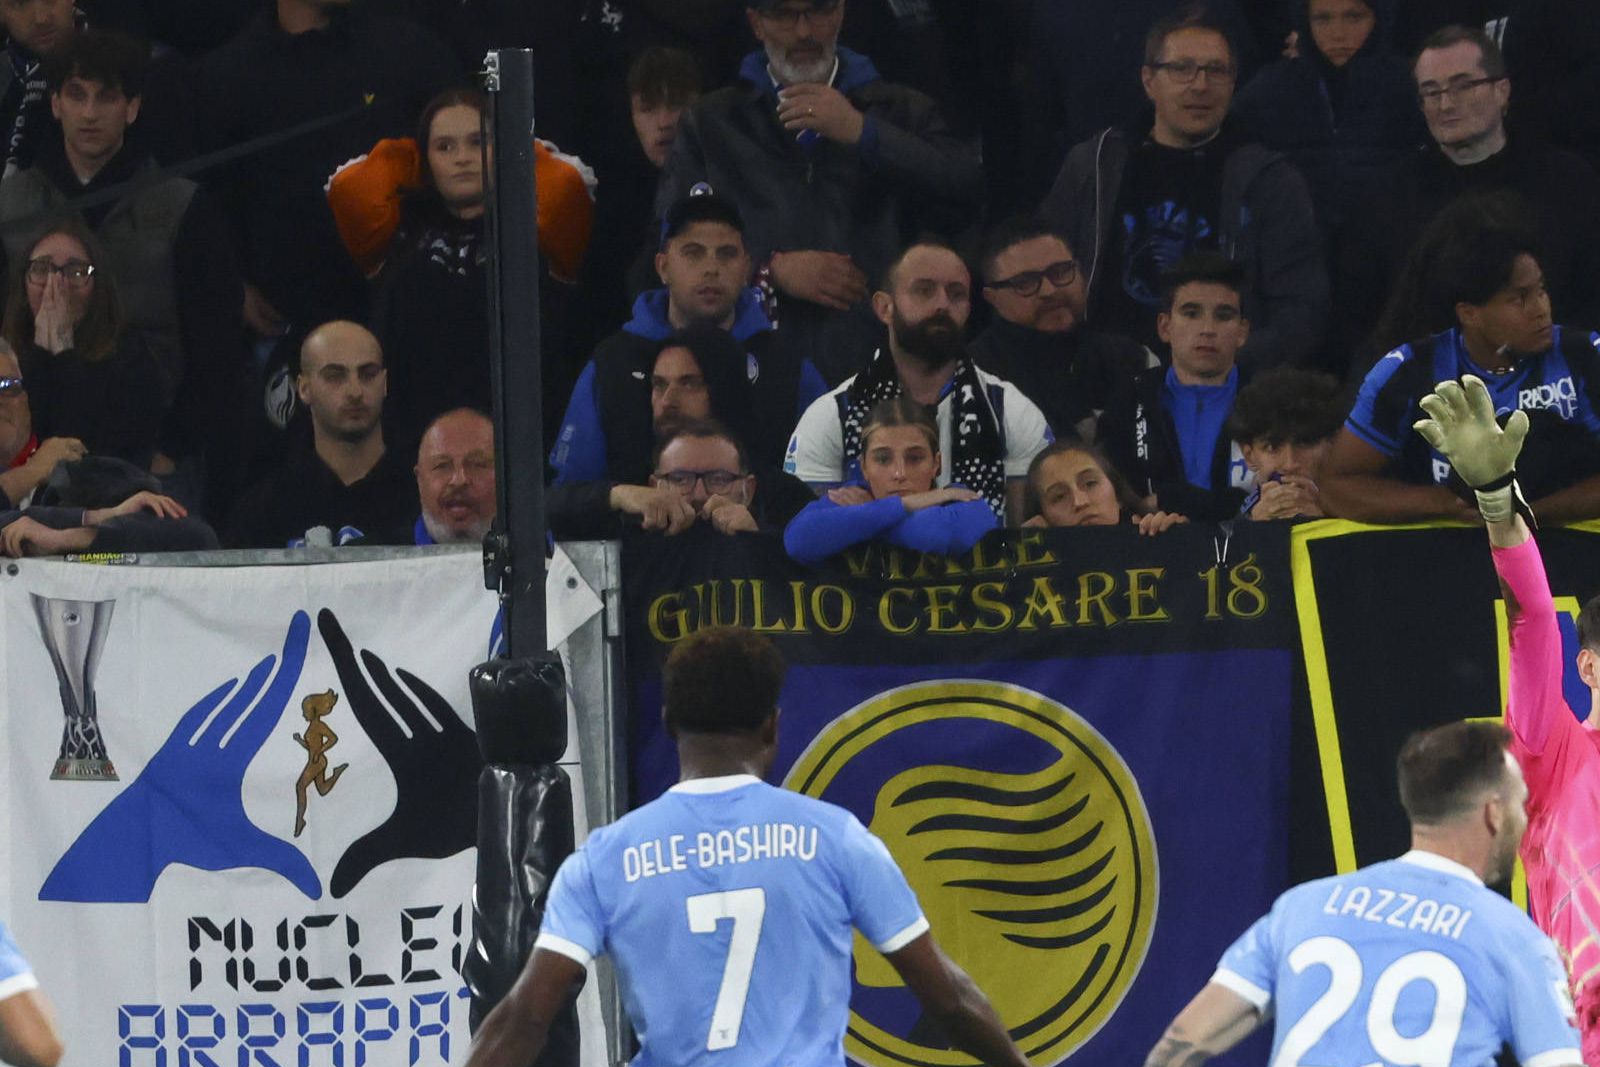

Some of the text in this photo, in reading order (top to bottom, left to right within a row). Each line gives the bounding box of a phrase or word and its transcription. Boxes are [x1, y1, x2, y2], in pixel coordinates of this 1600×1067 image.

[647, 552, 1268, 643] GIULIO CESARE 18
[622, 823, 819, 884] DELE-BASHIRU
[1323, 883, 1473, 941] LAZZARI
[686, 886, 767, 1052] 7
